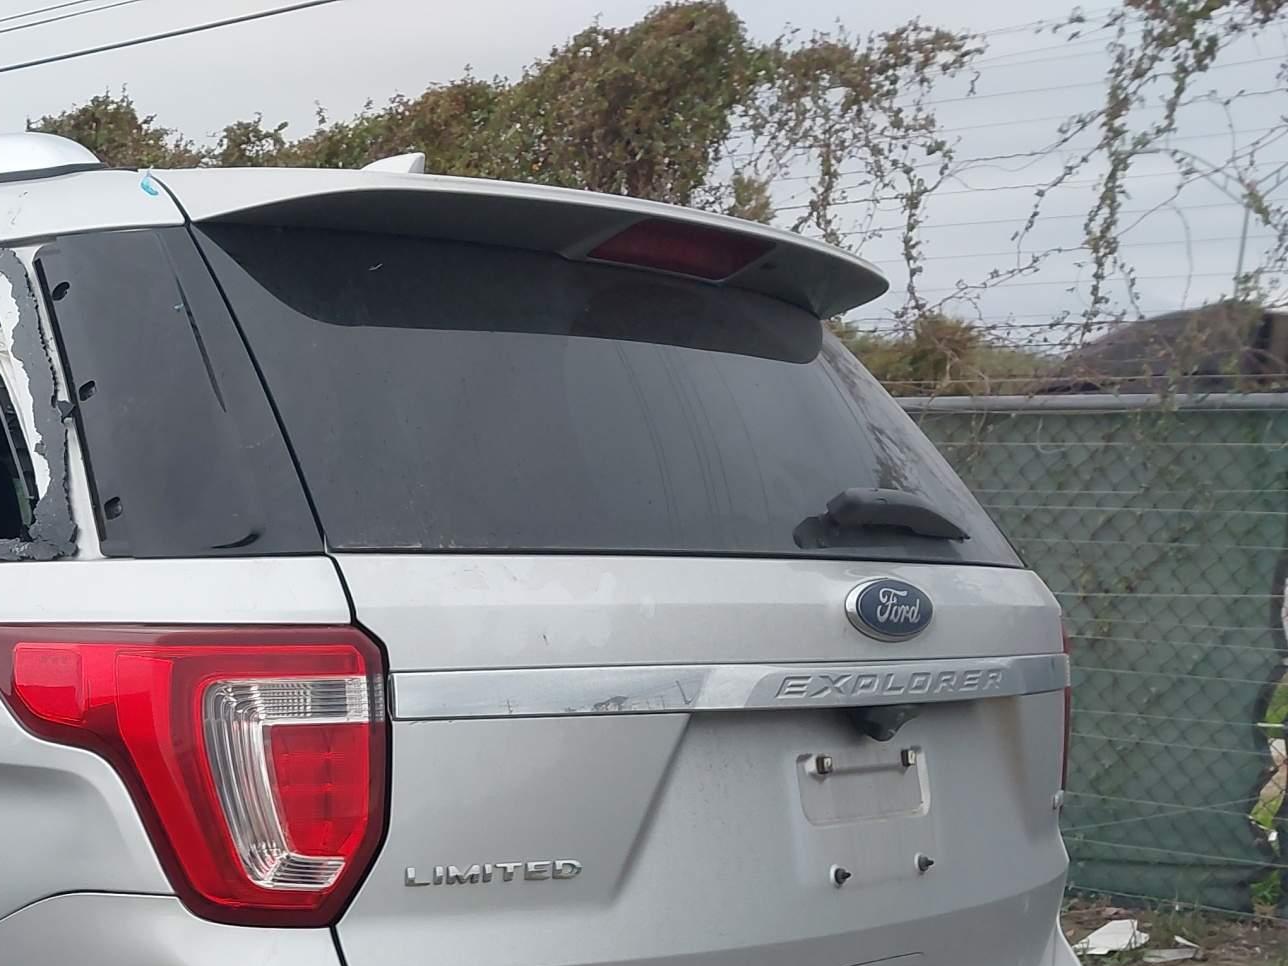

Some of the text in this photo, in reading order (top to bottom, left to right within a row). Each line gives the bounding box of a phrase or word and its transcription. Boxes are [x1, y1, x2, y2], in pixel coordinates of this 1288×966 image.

[876, 587, 920, 624] Ford
[774, 668, 1005, 699] EXPLORER
[404, 858, 585, 887] LIMITED
